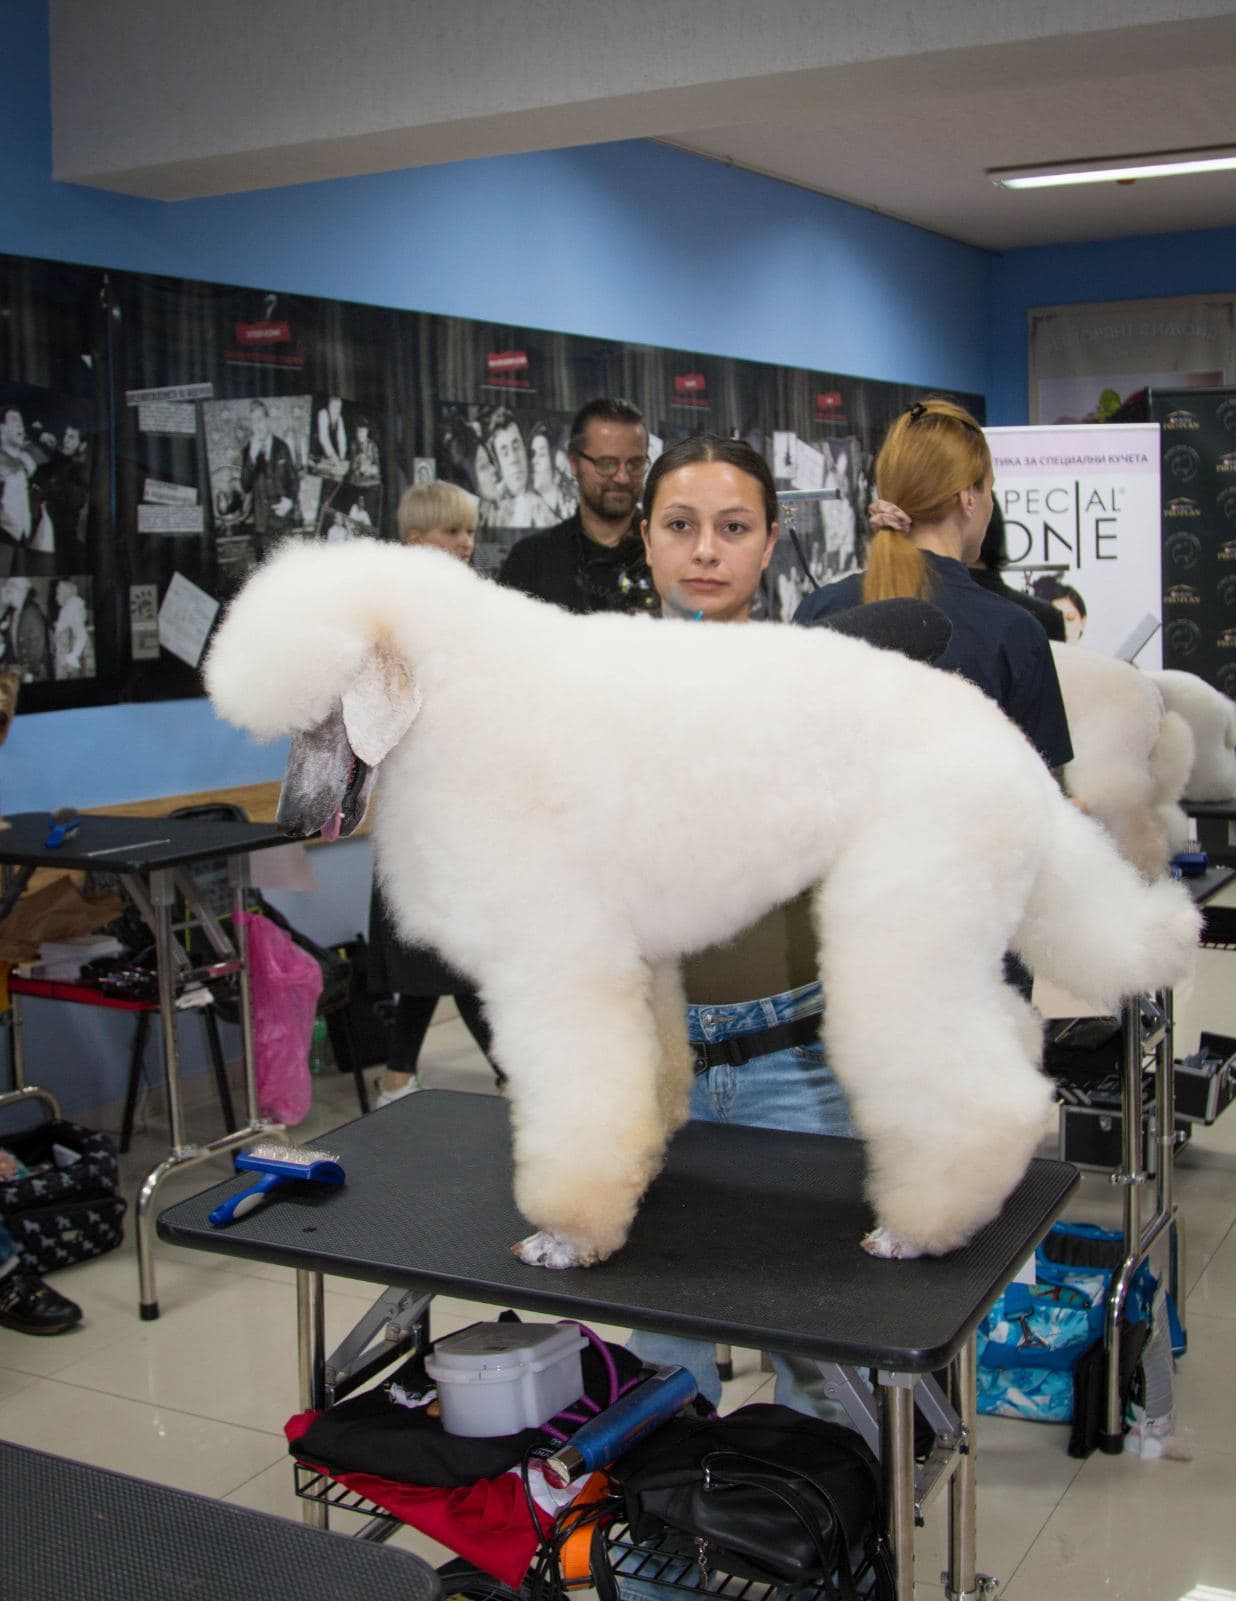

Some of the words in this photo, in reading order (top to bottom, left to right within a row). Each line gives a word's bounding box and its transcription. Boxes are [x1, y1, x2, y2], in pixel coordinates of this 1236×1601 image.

[1024, 456, 1037, 466] ЗА
[1039, 455, 1106, 466] СПЕЦИАЛНИ
[1108, 453, 1148, 464] КУЧЕТА
[1004, 484, 1121, 514] PECIAL
